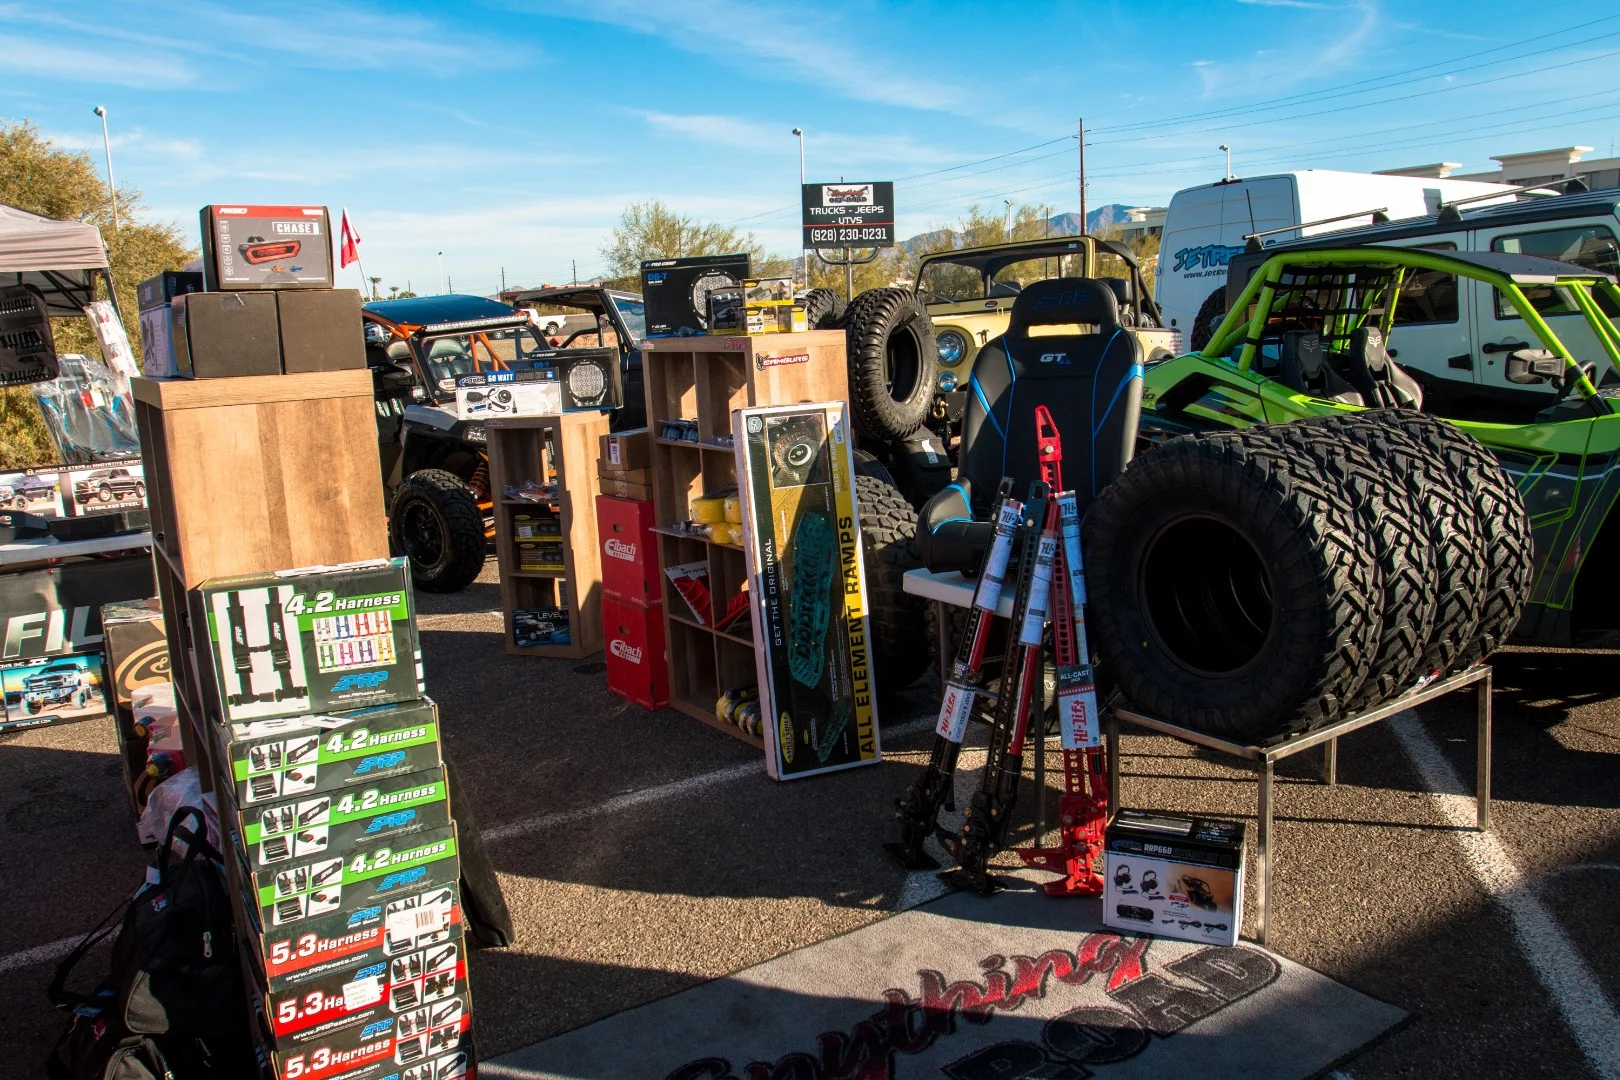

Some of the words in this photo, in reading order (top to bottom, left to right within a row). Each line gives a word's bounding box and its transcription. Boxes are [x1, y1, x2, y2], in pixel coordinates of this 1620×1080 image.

[809, 206, 846, 215] TRUCKS
[854, 205, 884, 214] JEEPS
[276, 223, 311, 233] CHASE
[811, 228, 837, 243] (928)
[839, 227, 887, 240] 230-0231
[647, 272, 668, 280] DS-7
[1039, 353, 1067, 363] GT
[497, 373, 514, 382] WATT
[86, 503, 120, 512] STAINLESS
[604, 538, 636, 557] Eibach
[839, 516, 859, 595] RAMPS
[765, 538, 777, 599] ORIGINAL
[285, 591, 335, 616] 4.2
[335, 593, 401, 611] Harness
[774, 625, 782, 646] GET
[609, 639, 642, 659] Eibach
[847, 605, 870, 708] ELEMENT
[1060, 669, 1090, 680] ALL-CAST
[326, 728, 370, 754] 4.2
[369, 726, 426, 747] Harness
[858, 715, 875, 754] ALL
[336, 789, 380, 815] 4.2
[379, 784, 437, 806] Harness
[349, 848, 391, 874] 4.2
[391, 841, 447, 866] Harness
[270, 933, 319, 966] 5.3
[317, 927, 380, 952] Harness
[285, 952, 369, 982] www.PRPseats.com
[278, 990, 325, 1024] 5.3
[293, 1010, 375, 1041] www.PRPseats.com
[285, 1047, 331, 1080] 5.3
[330, 1039, 391, 1065] Harness
